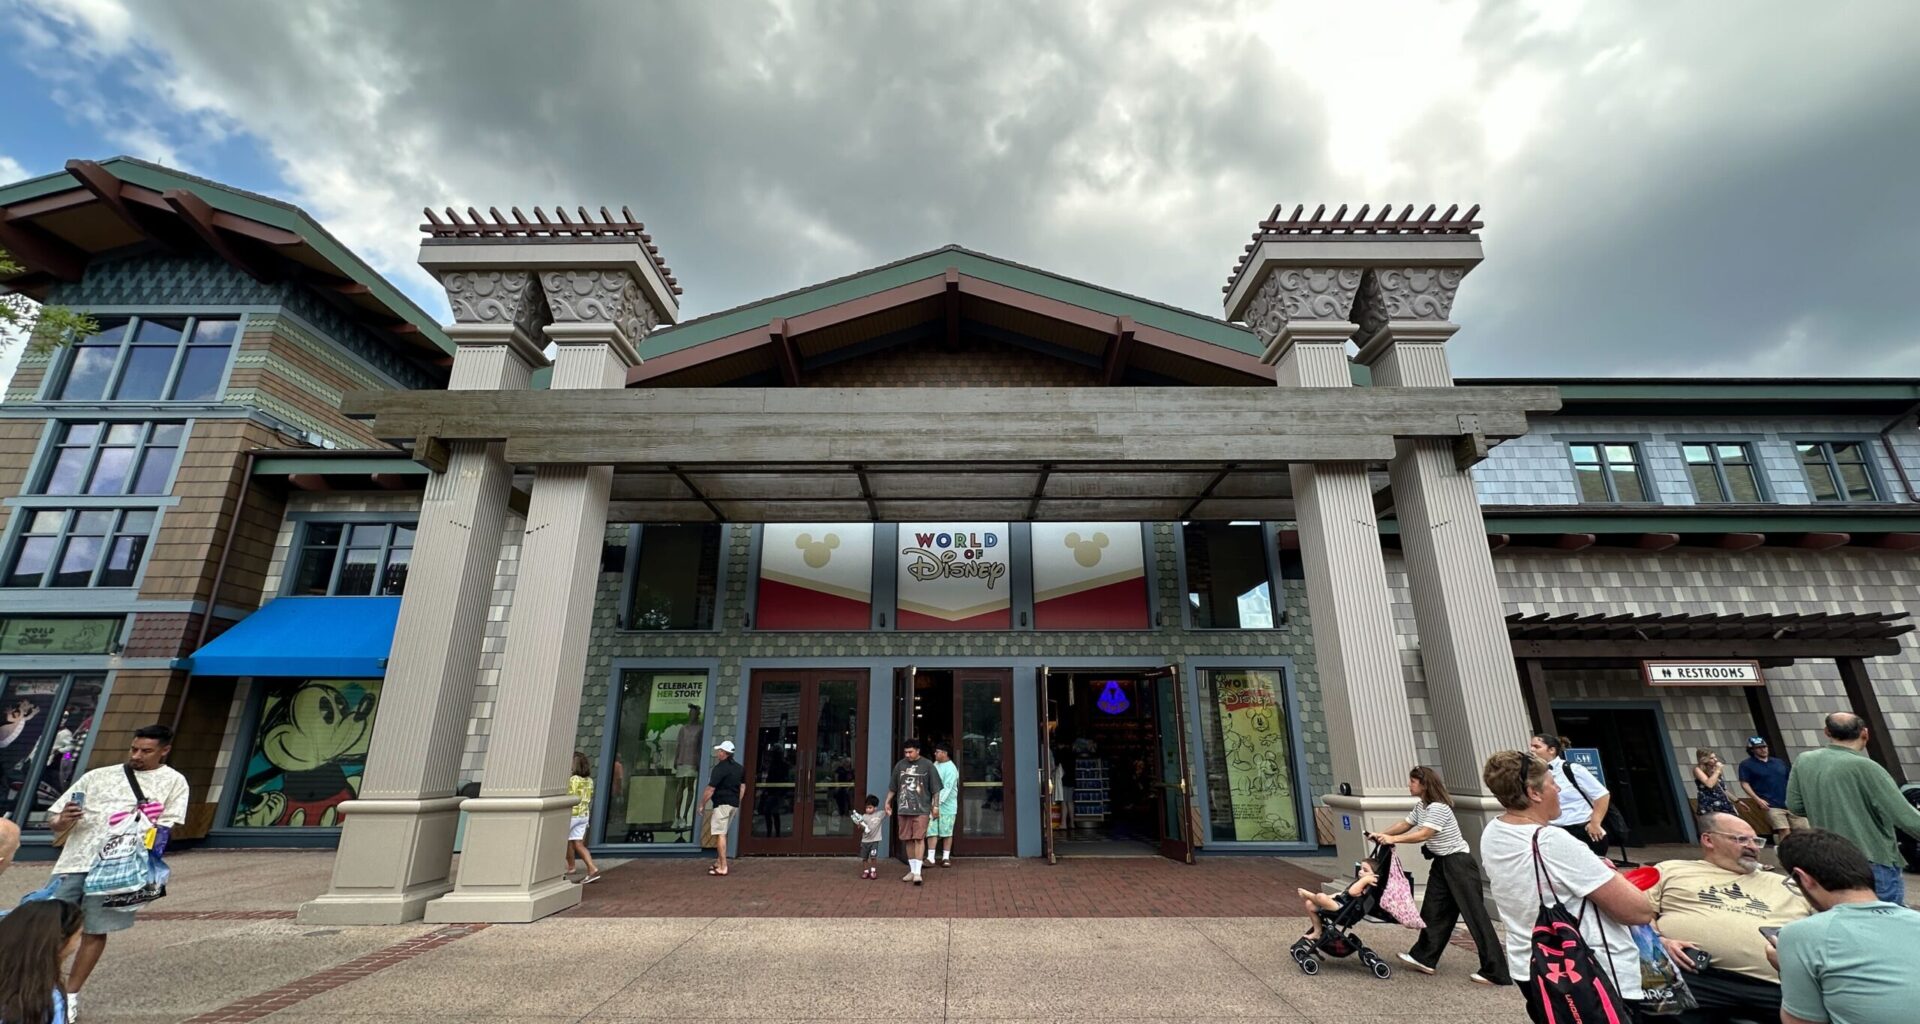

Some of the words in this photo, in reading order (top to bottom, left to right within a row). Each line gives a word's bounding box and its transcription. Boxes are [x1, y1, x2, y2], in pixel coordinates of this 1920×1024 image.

[915, 532, 998, 548] WORLD
[964, 549, 983, 560] OF
[902, 547, 1005, 590] Disney
[1677, 667, 1745, 678] RESTROOMS
[657, 682, 703, 690] CELEBRATE
[674, 690, 702, 698] STORY
